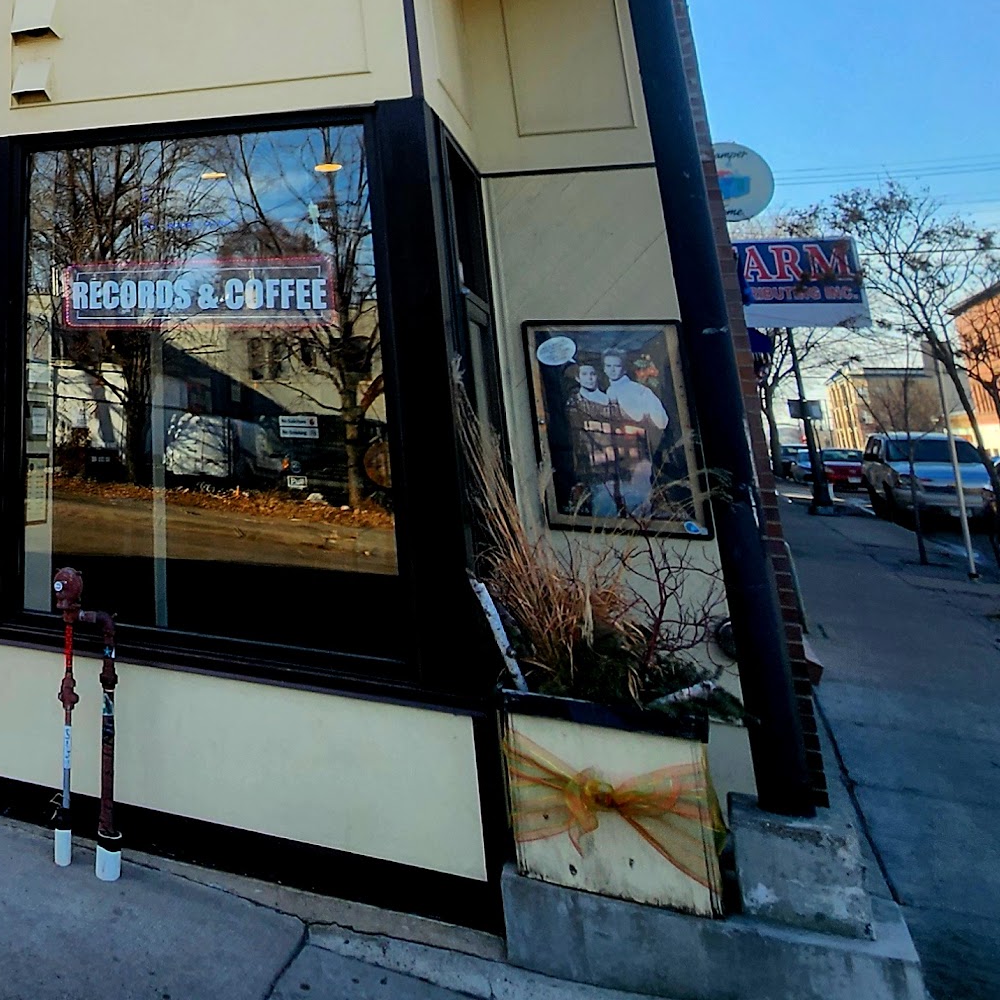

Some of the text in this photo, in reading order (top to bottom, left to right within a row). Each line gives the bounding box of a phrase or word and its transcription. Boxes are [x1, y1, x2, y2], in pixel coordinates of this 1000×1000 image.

[735, 243, 856, 283] ARM
[72, 278, 328, 311] RECORDS & COFFEE
